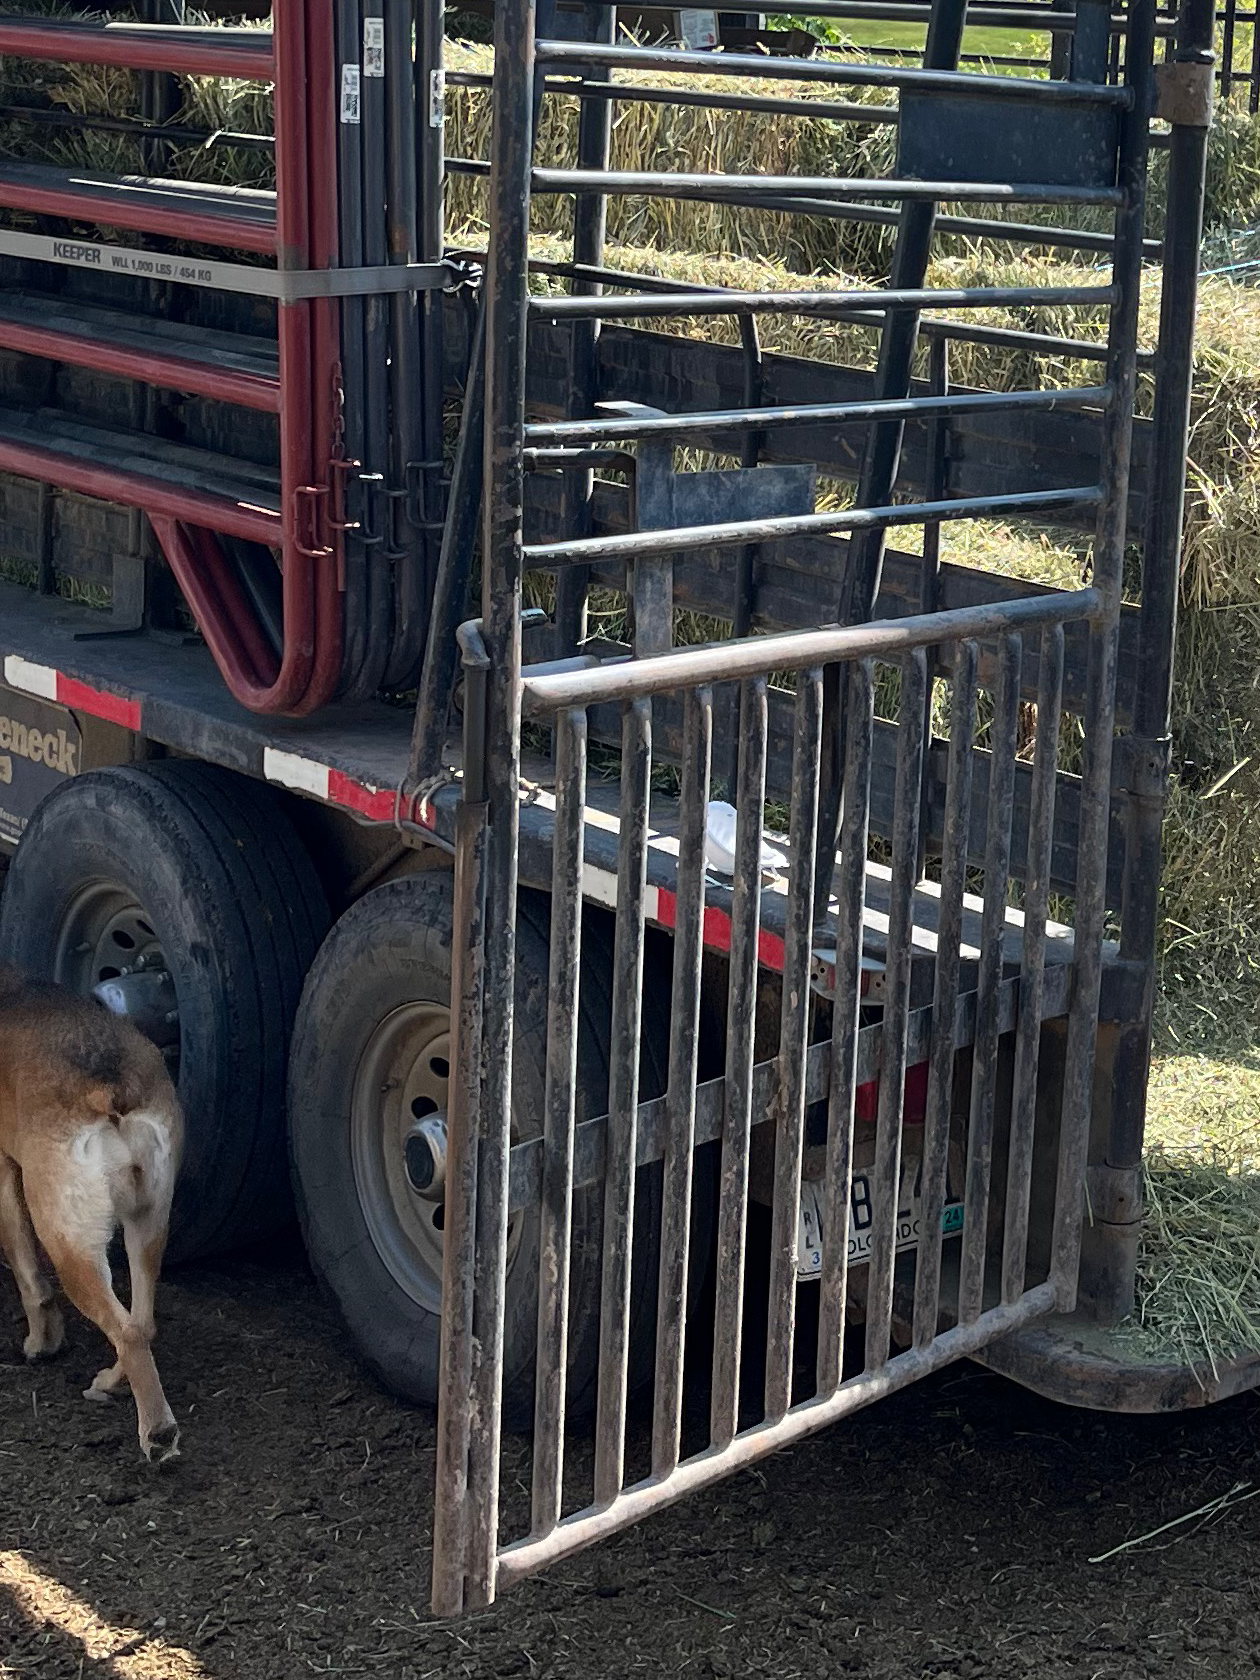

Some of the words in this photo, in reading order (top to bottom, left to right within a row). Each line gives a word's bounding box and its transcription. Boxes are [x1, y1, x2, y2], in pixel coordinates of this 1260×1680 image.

[53, 242, 101, 264] KEEPER
[111, 255, 129, 269] WLL
[131, 259, 154, 273] 1,000
[155, 262, 172, 276] LBS
[179, 266, 196, 279] 454
[197, 269, 212, 282] KG
